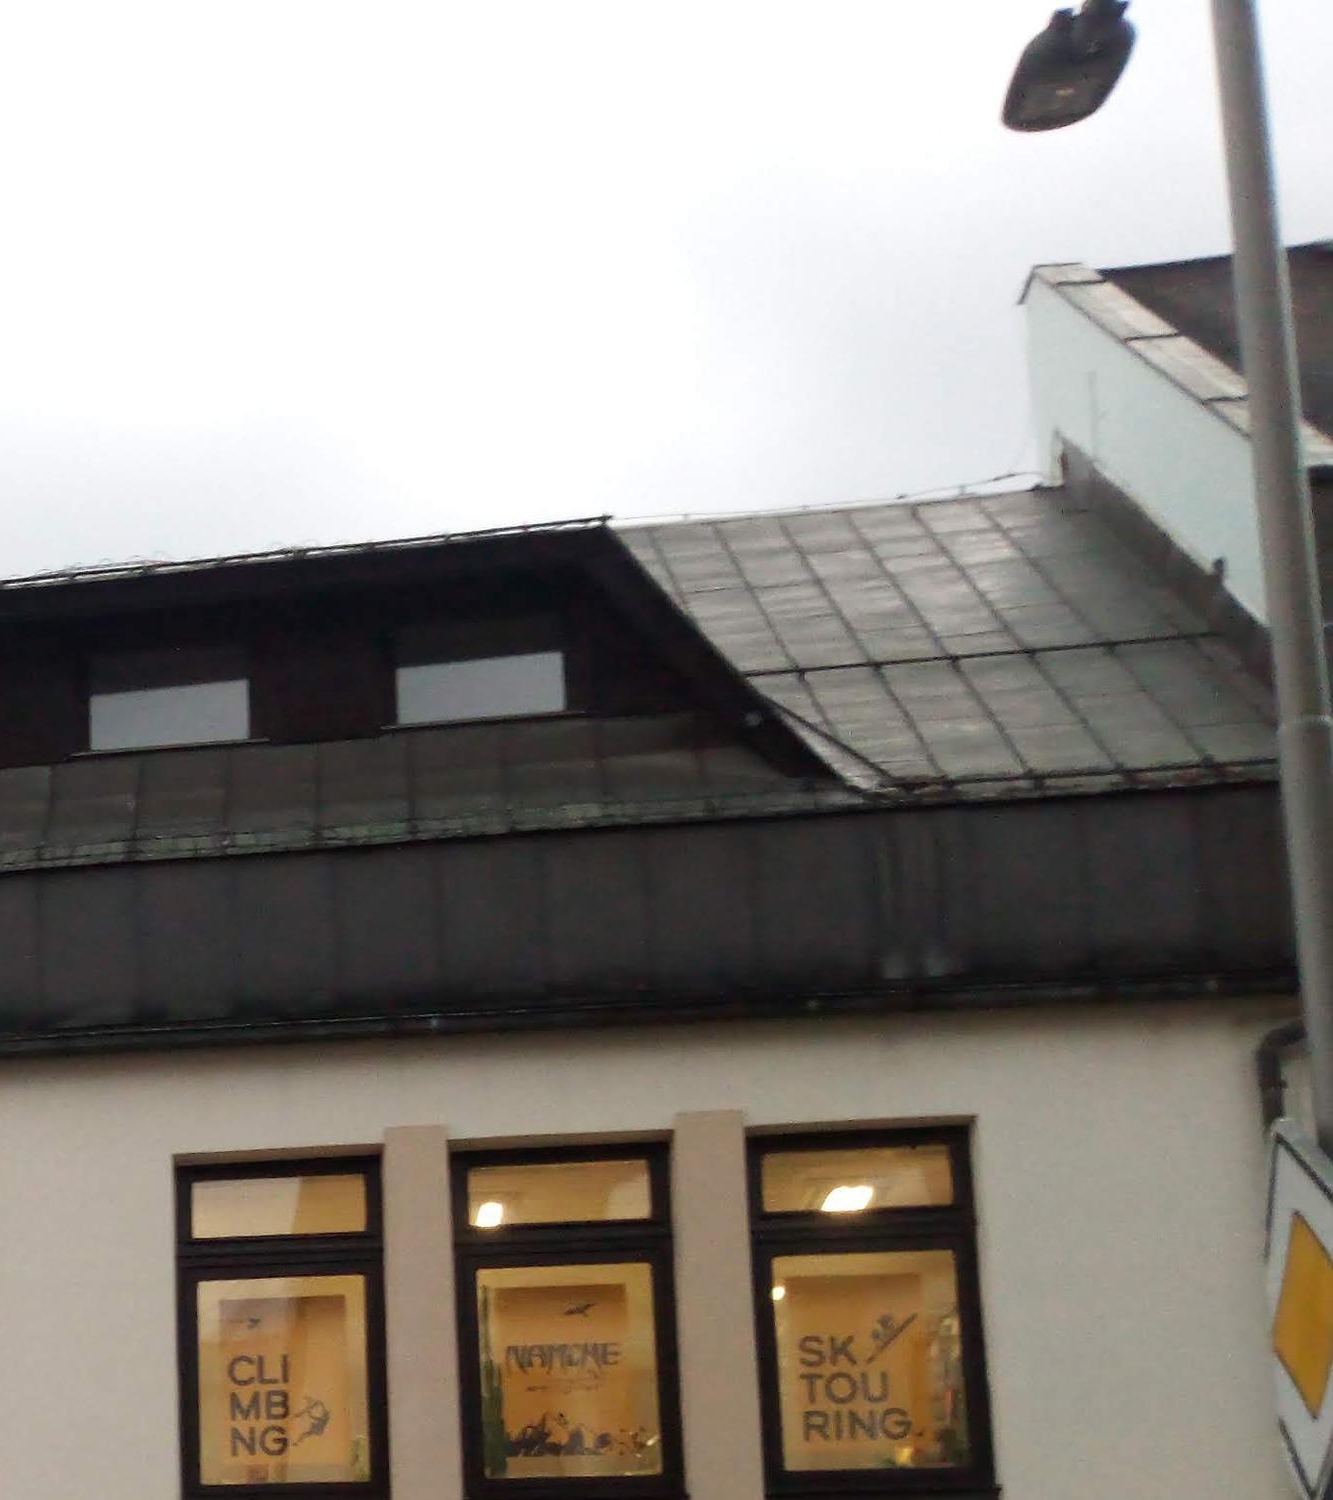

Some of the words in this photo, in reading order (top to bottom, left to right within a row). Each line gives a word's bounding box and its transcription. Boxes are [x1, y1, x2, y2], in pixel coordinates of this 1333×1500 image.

[798, 1334, 858, 1368] SK
[228, 1353, 290, 1386] CLI
[799, 1371, 889, 1404] TOU
[229, 1389, 290, 1421] MB
[230, 1424, 290, 1457] NG
[802, 1406, 912, 1442] RING
